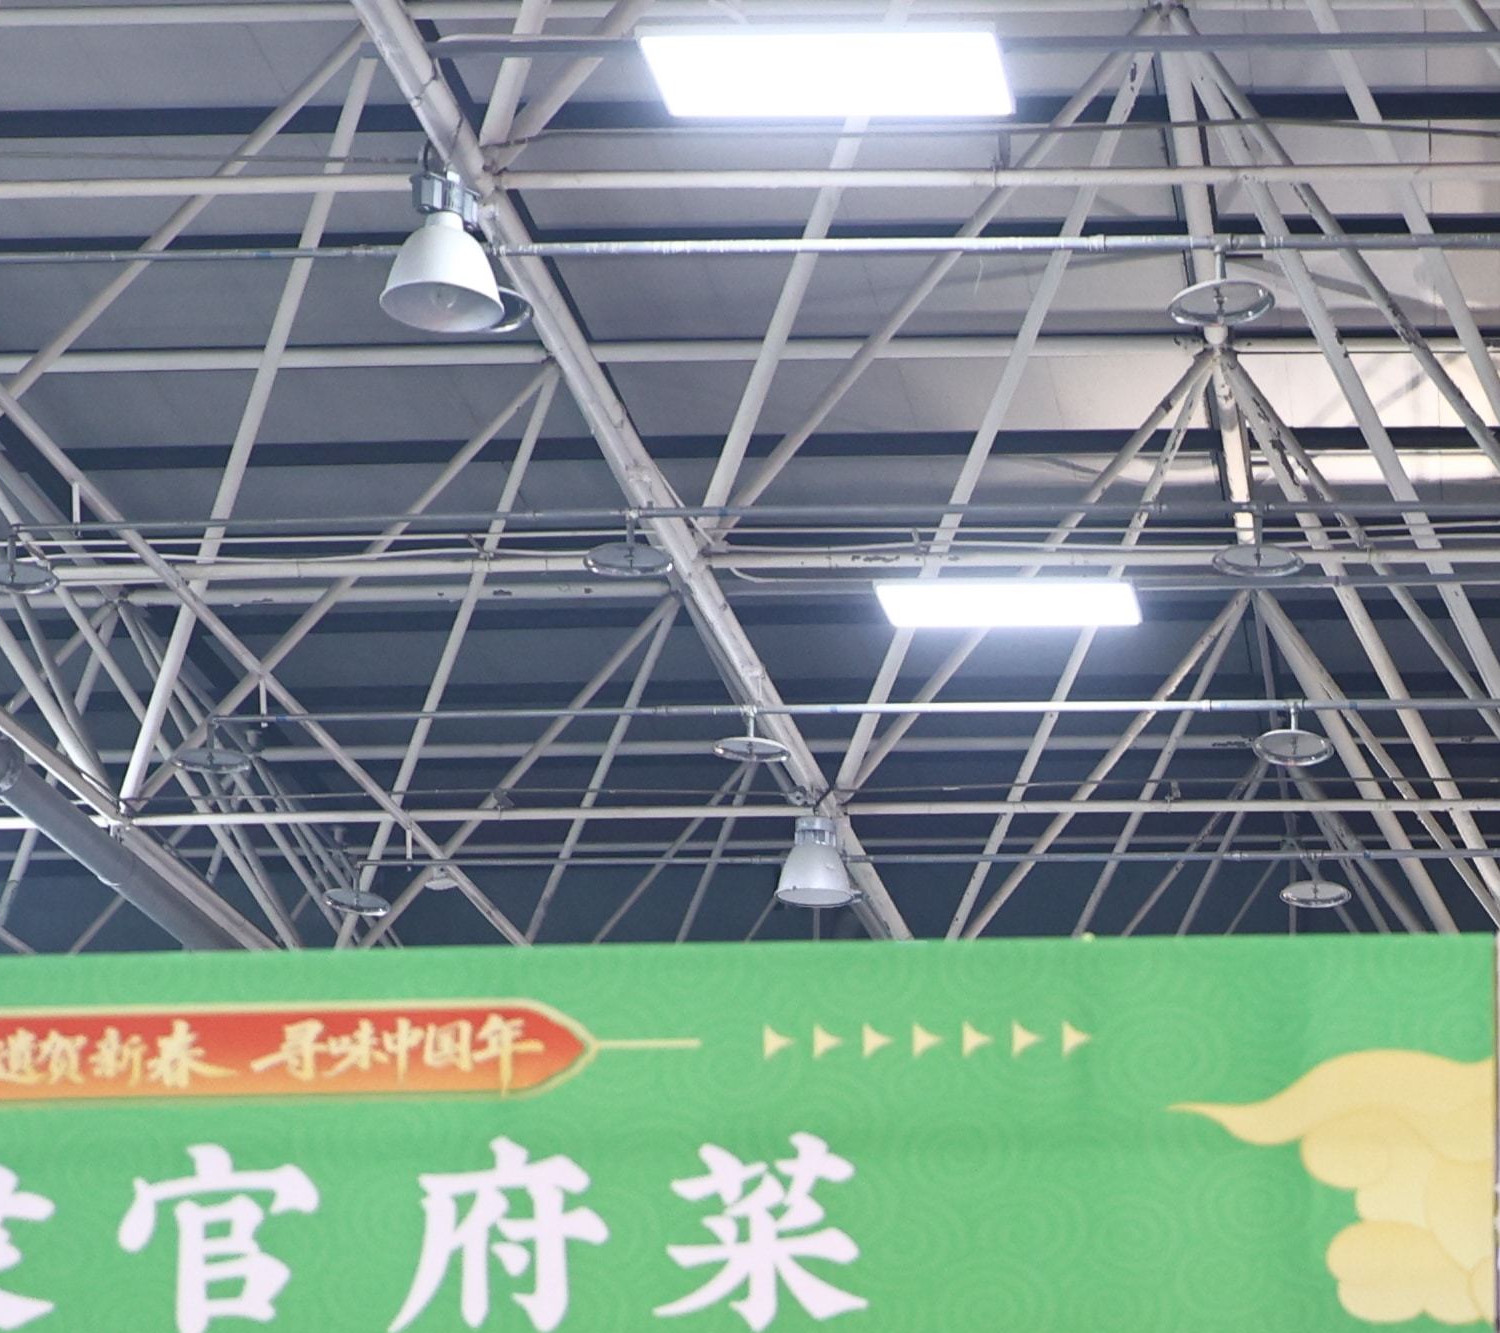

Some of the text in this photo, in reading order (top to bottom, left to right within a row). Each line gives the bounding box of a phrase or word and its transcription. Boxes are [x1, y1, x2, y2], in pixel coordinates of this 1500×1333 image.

[250, 1012, 545, 1096] 寻味中国年
